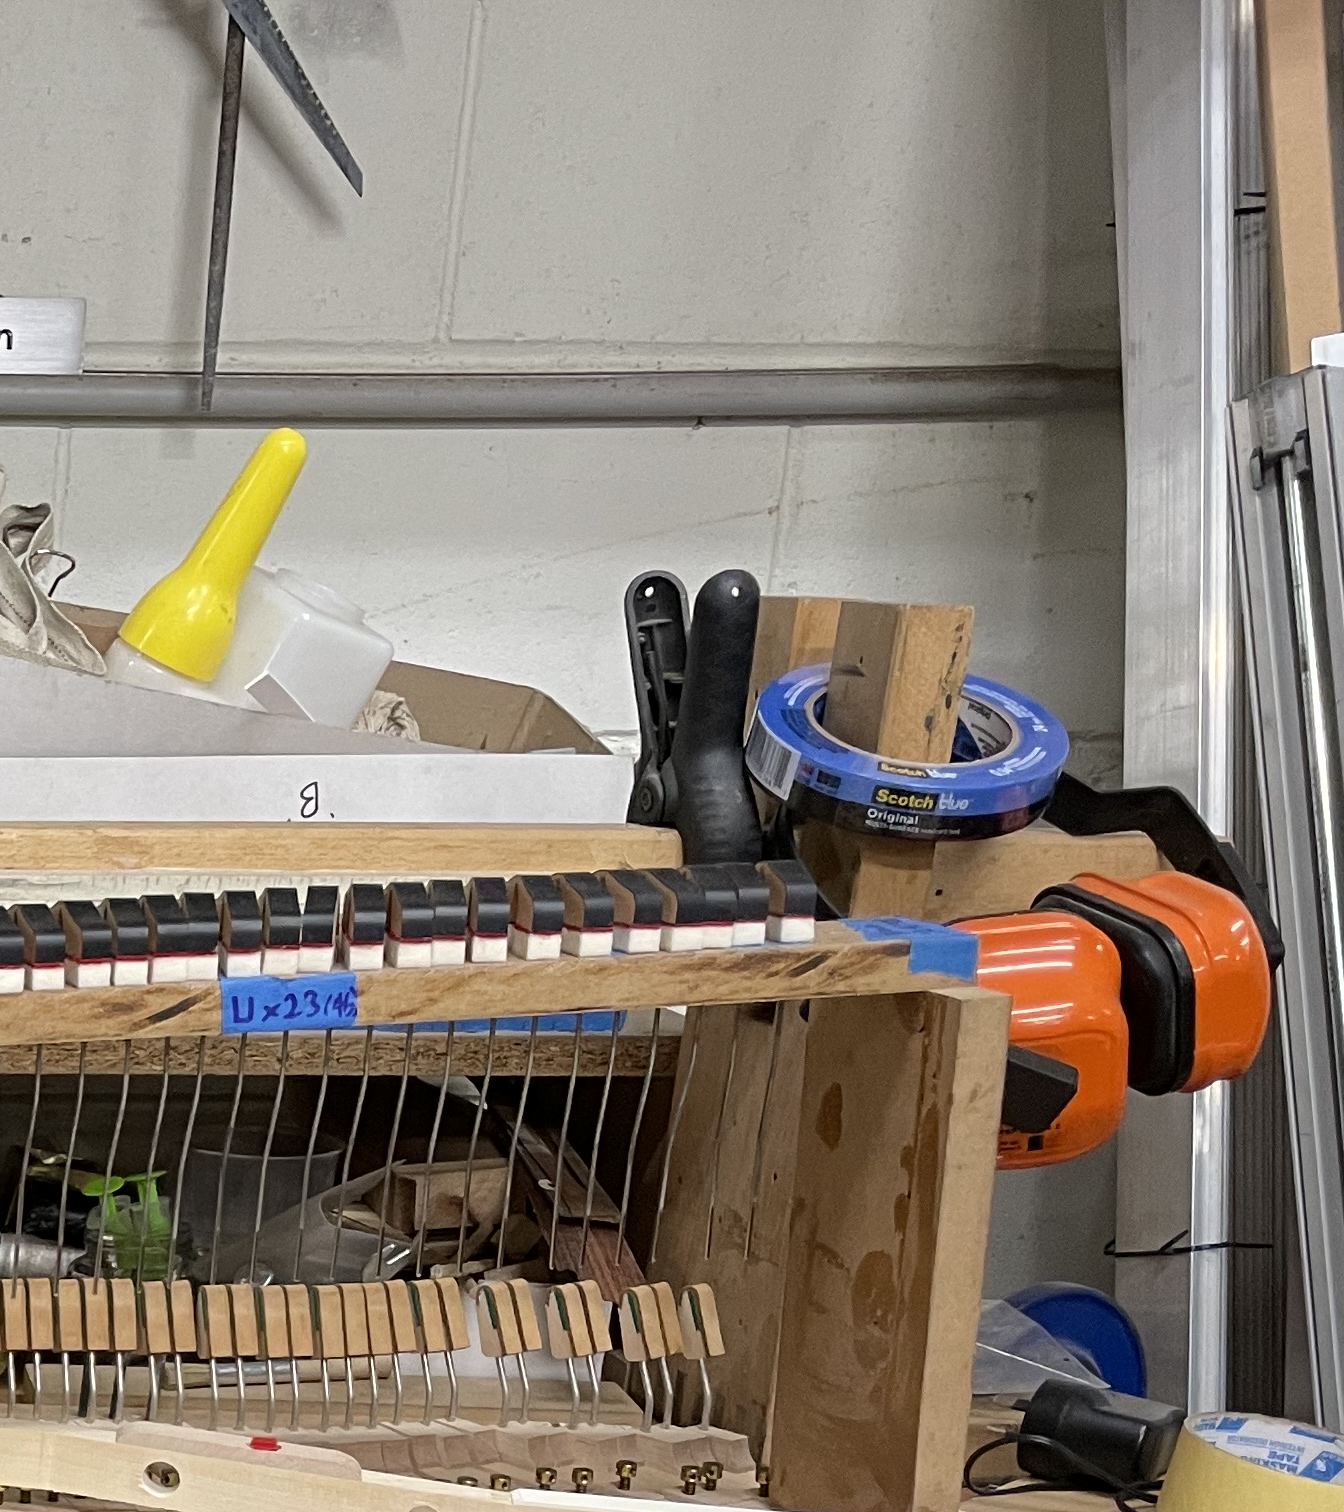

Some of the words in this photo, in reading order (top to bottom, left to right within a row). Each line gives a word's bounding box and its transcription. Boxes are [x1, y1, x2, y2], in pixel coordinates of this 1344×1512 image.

[875, 788, 934, 810] Scotch
[867, 808, 919, 825] Original
[231, 995, 255, 1023] U
[261, 1003, 282, 1022] x
[283, 989, 320, 1019] 23
[1268, 1450, 1300, 1465] TAPE
